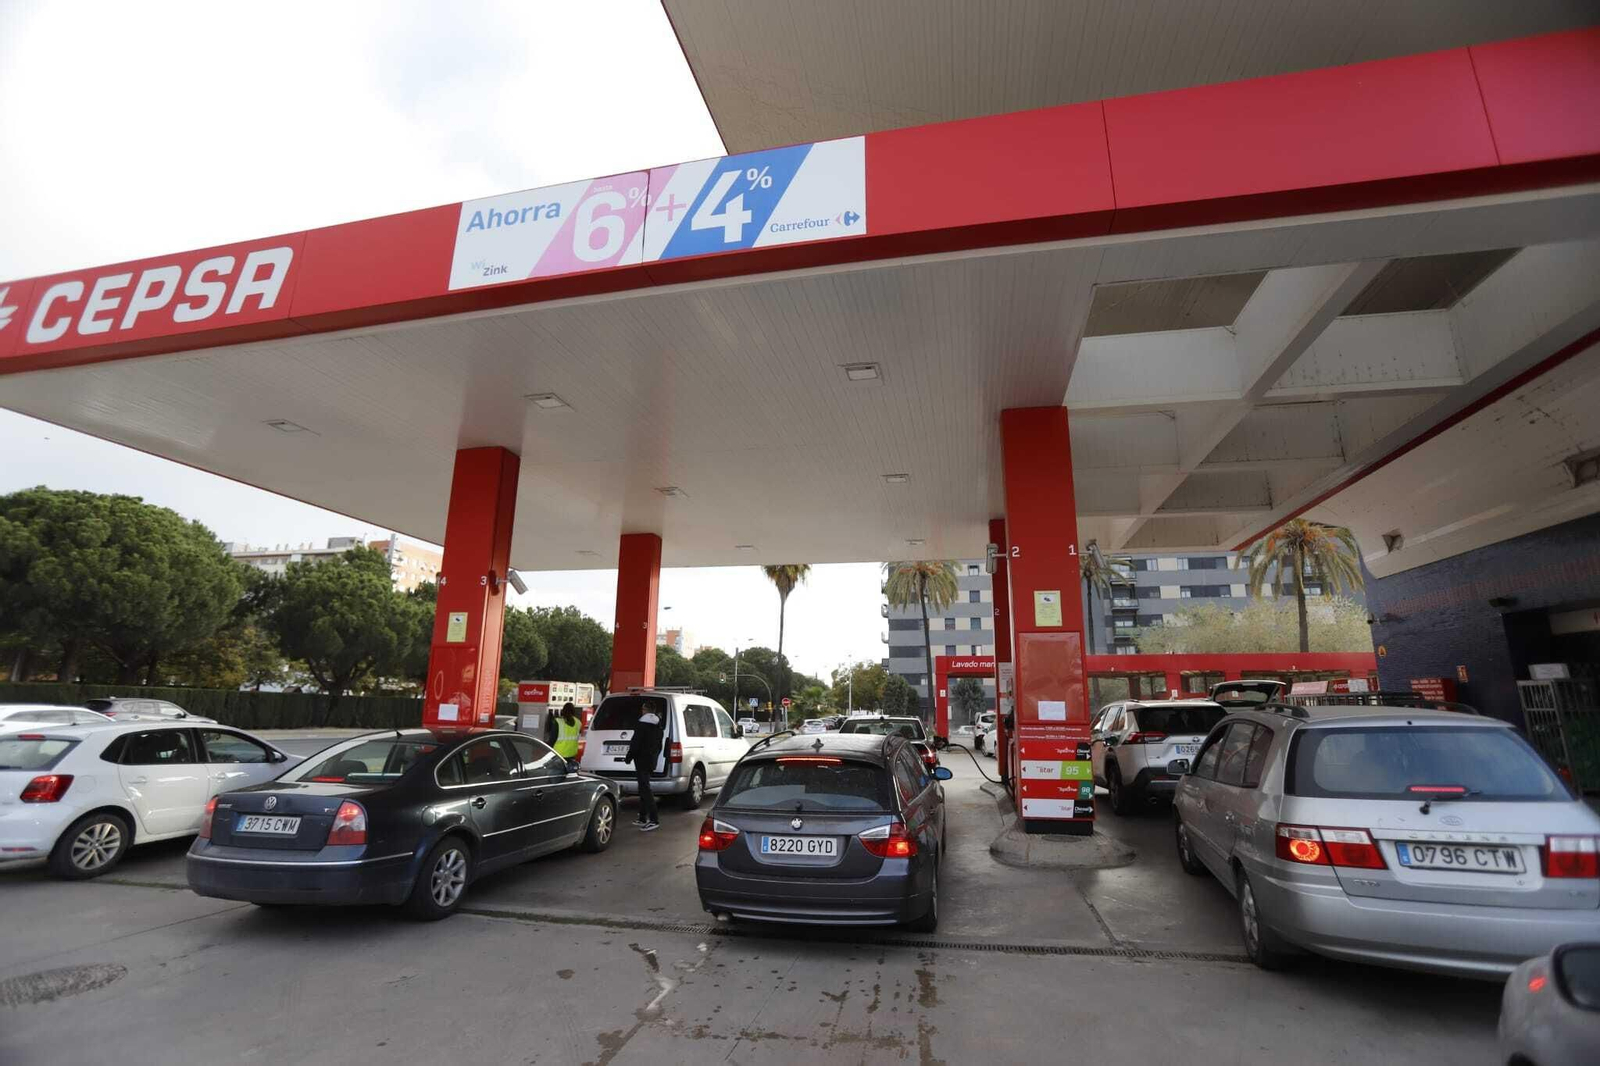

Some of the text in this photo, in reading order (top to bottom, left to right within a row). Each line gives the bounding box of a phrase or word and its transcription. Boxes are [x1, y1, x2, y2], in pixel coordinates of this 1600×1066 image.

[691, 165, 772, 243] 4%
[466, 201, 561, 233] Ahorra
[770, 215, 830, 234] Carrefour
[25, 246, 294, 345] CEPSA
[1011, 546, 1021, 558] 2
[1068, 544, 1077, 556] 1
[440, 576, 447, 586] 4
[480, 575, 488, 586] 3
[994, 608, 1000, 616] 2
[951, 660, 979, 668] Lavado
[1065, 765, 1080, 775] 95
[245, 817, 273, 831] 3715
[770, 838, 833, 854] 8220 GYD
[1412, 844, 1518, 868] 0796 CTW
